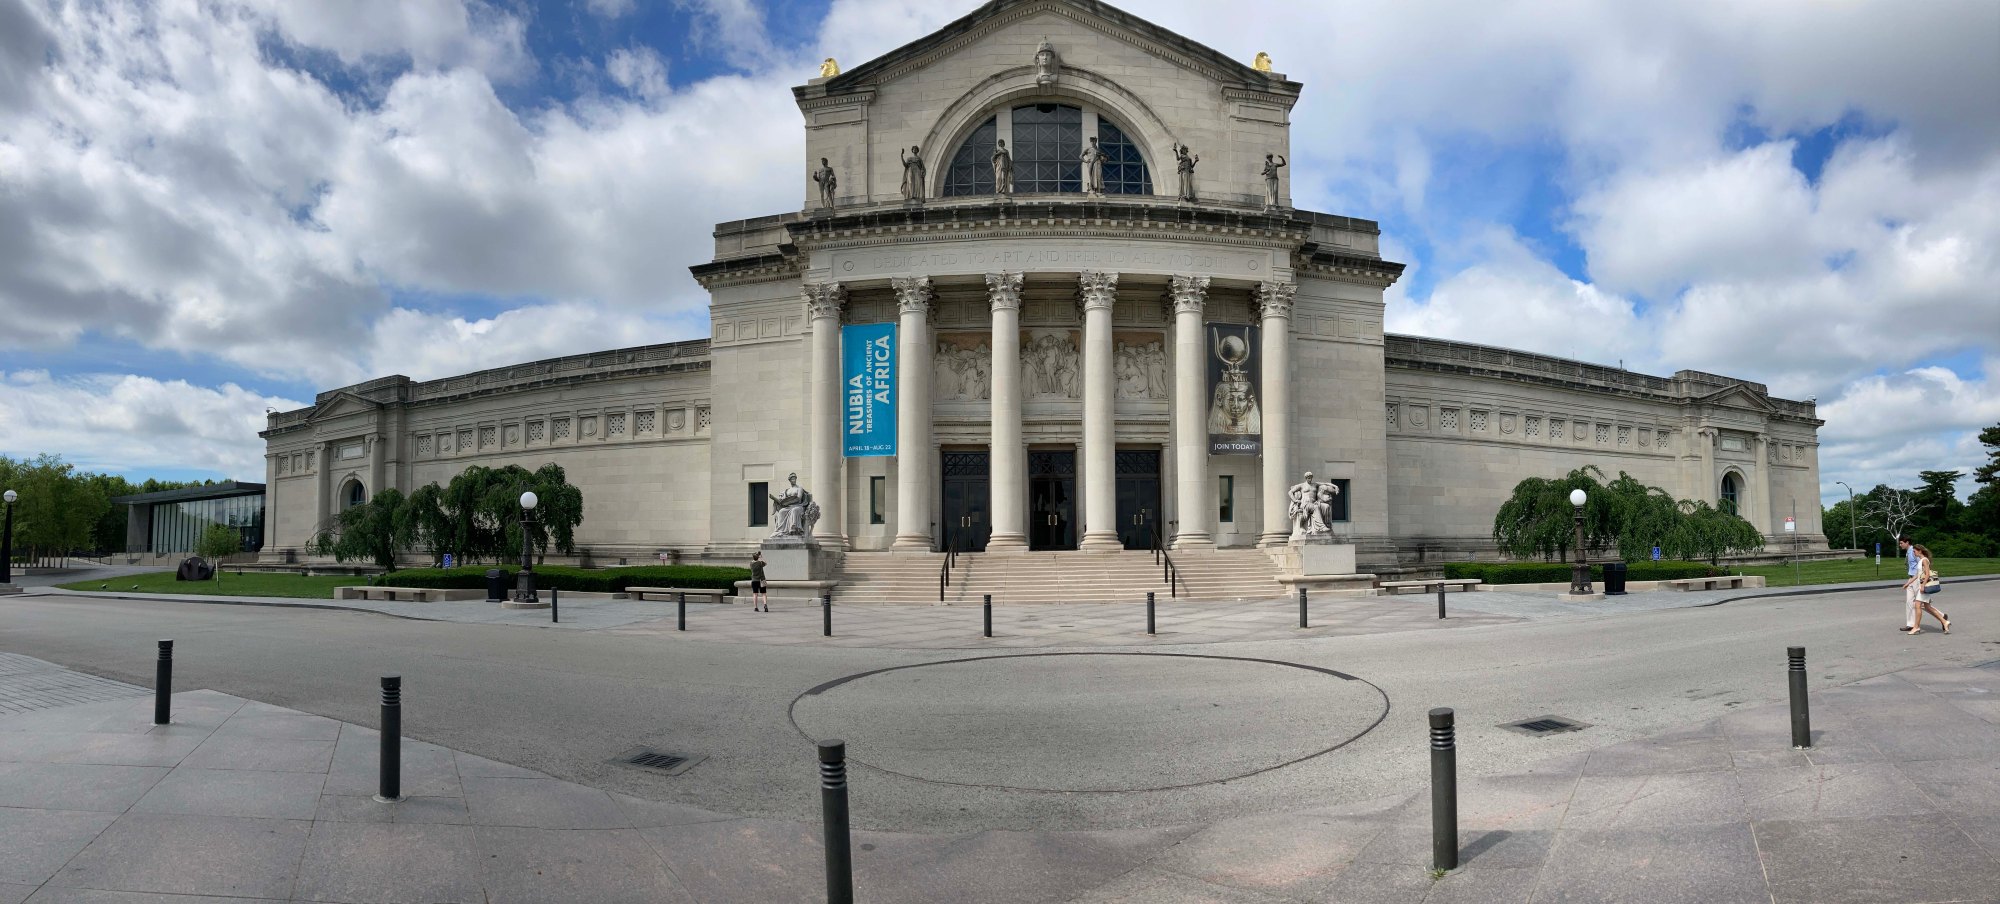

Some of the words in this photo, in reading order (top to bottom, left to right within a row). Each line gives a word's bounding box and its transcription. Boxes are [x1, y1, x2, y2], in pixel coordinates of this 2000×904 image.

[873, 253, 958, 269] DEDICATED
[966, 252, 986, 264] TO
[992, 251, 1023, 263] ART
[1026, 251, 1060, 263] AND
[1064, 250, 1102, 263] FREE
[1108, 251, 1126, 263] TO
[1131, 253, 1161, 265] ALL
[874, 335, 890, 405] AFRICA
[866, 375, 873, 387] OF
[849, 373, 864, 435] NUBIA
[1214, 443, 1230, 451] JOIN
